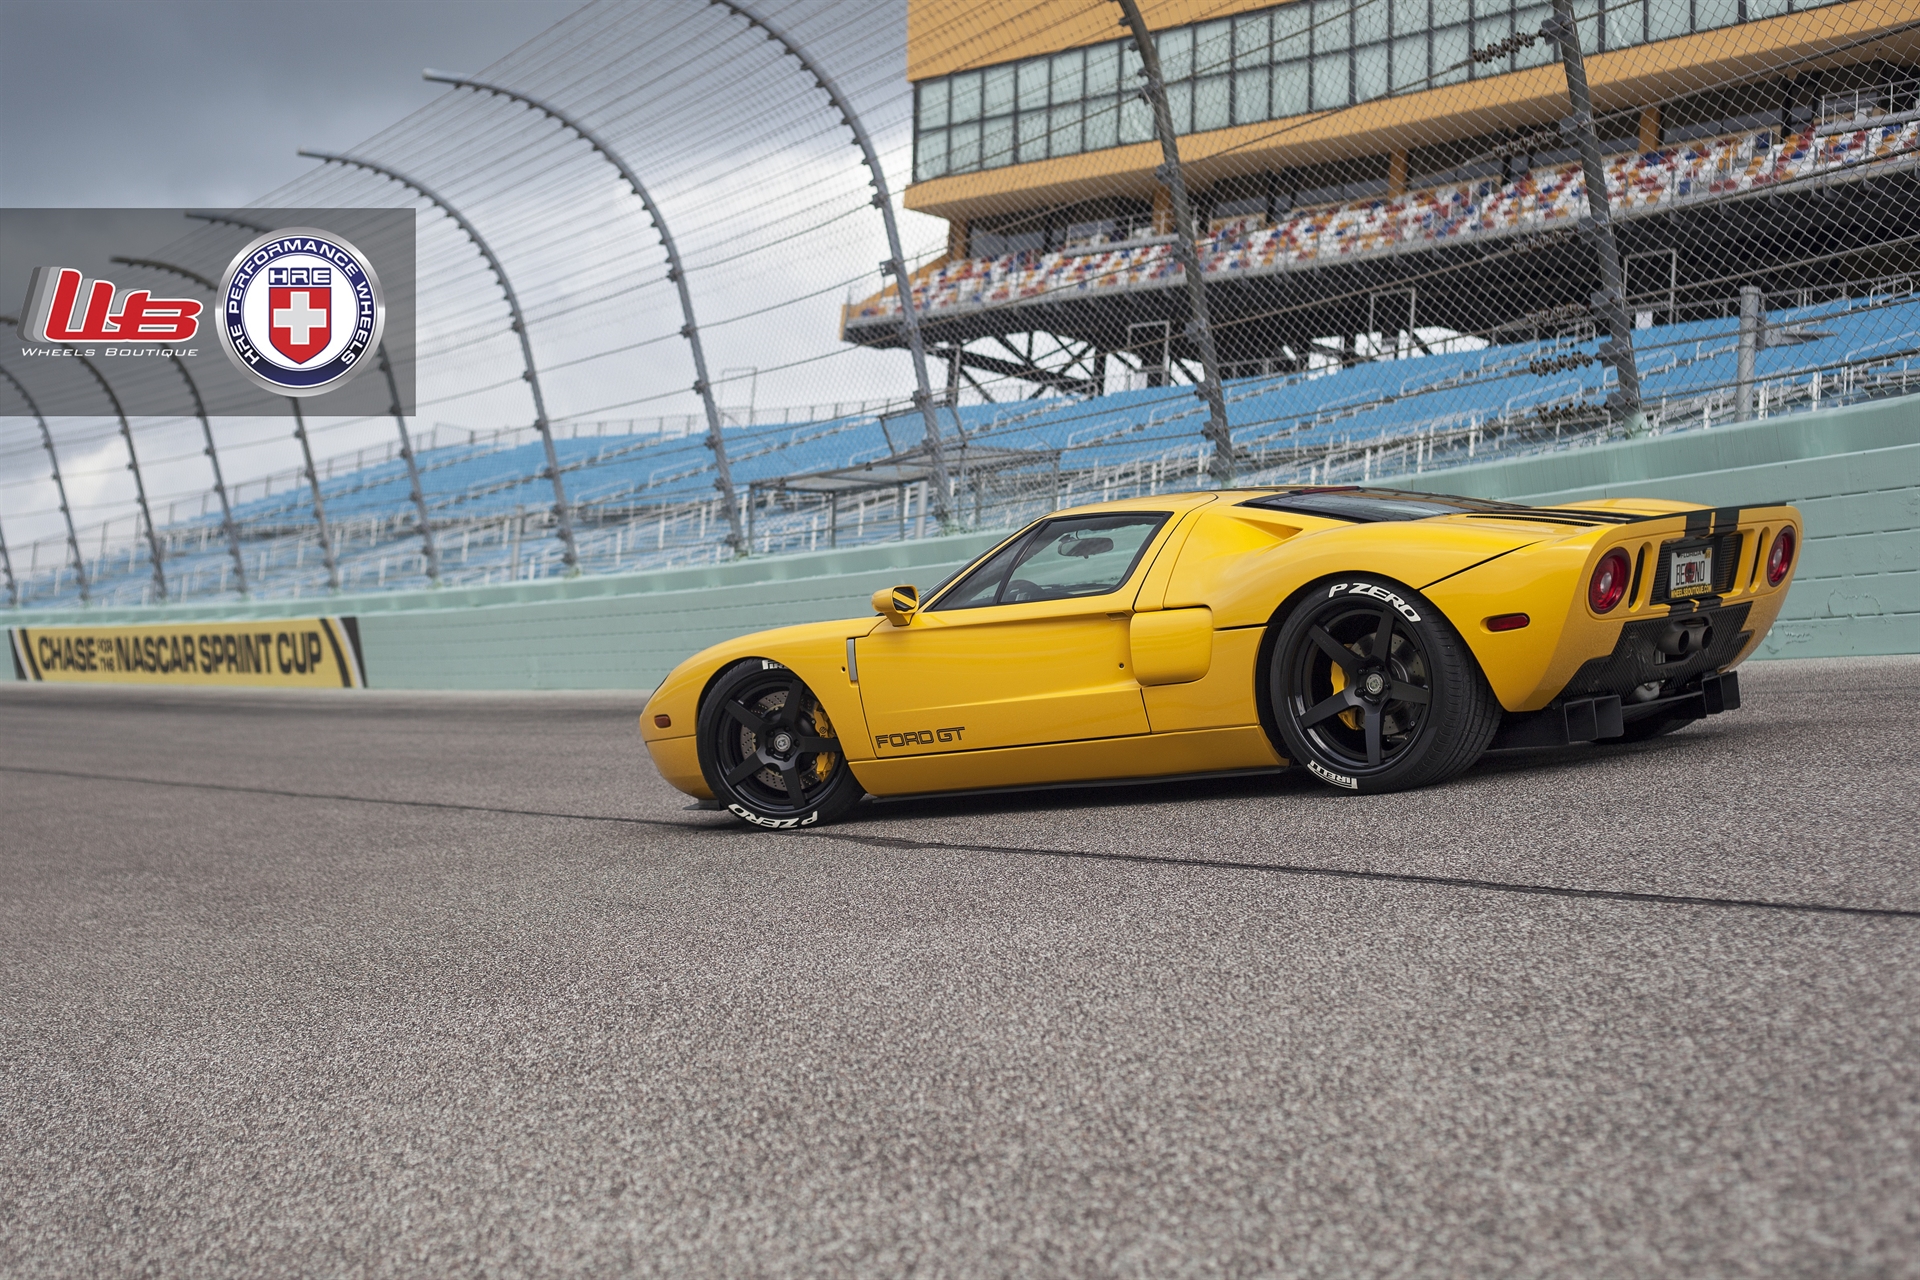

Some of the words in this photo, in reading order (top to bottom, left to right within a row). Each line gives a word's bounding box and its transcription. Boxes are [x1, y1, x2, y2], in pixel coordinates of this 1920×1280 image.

[1328, 583, 1348, 598] P
[1349, 582, 1421, 623] ZERO
[38, 636, 98, 672] CHASE
[97, 638, 113, 653] FOR
[115, 635, 198, 673] NASCAR
[199, 634, 272, 674] SPRINT
[277, 632, 323, 675] CUP
[99, 656, 115, 672] THE
[875, 730, 935, 749] FORD
[936, 726, 965, 743] GT
[728, 803, 800, 829] ZERO
[801, 810, 818, 826] P
